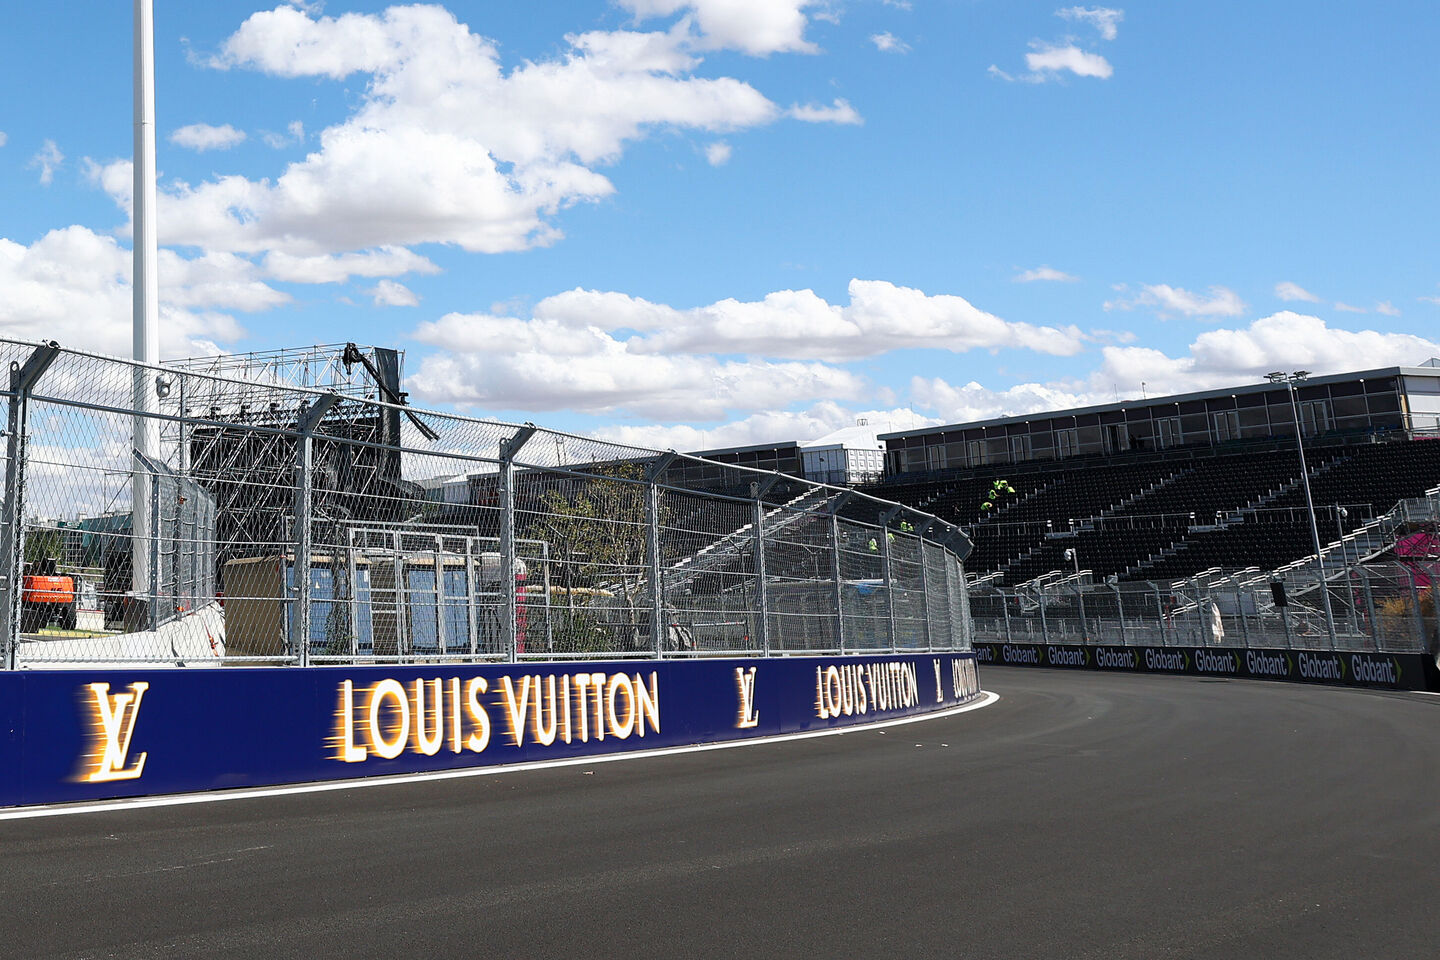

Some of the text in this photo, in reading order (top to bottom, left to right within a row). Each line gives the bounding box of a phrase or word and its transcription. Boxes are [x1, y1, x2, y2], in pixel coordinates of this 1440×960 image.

[1002, 645, 1038, 664] Globant
[1048, 646, 1085, 666] Globant
[1096, 646, 1135, 668] Globant
[1145, 647, 1185, 670] Globant
[1195, 649, 1236, 673] Globant
[1246, 650, 1288, 676] Globant
[1298, 652, 1341, 680] Globant
[1351, 654, 1396, 683] Globant
[340, 675, 491, 763] LOUIS
[503, 670, 661, 748] VUITTON
[816, 664, 867, 719] LOUIS
[866, 660, 919, 712] VUITTON
